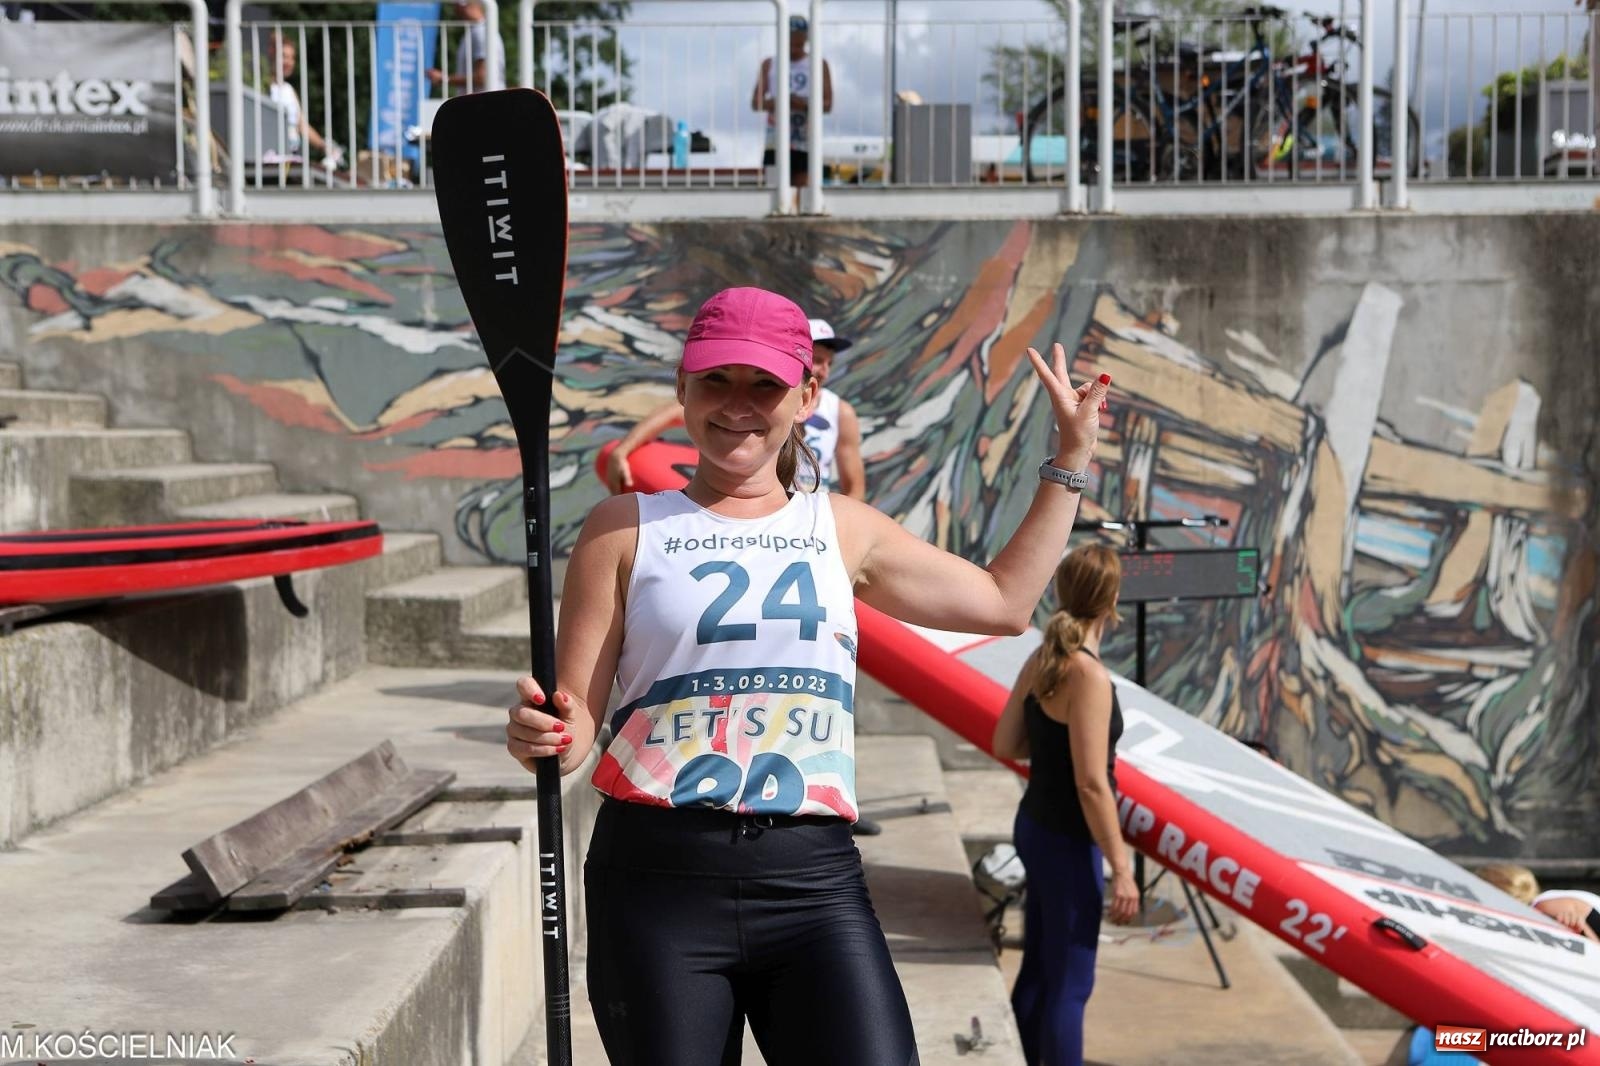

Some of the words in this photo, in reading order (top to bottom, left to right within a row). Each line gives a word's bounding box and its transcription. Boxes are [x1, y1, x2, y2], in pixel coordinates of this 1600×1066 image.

[482, 154, 519, 285] ITIWIT
[689, 560, 827, 645] 24
[1237, 550, 1257, 594] 5
[691, 674, 827, 692] 1-3.09.2023
[644, 707, 766, 747] LET'S
[786, 707, 834, 742] SU
[540, 853, 559, 939] ITIWIT
[1157, 822, 1262, 909] RACE
